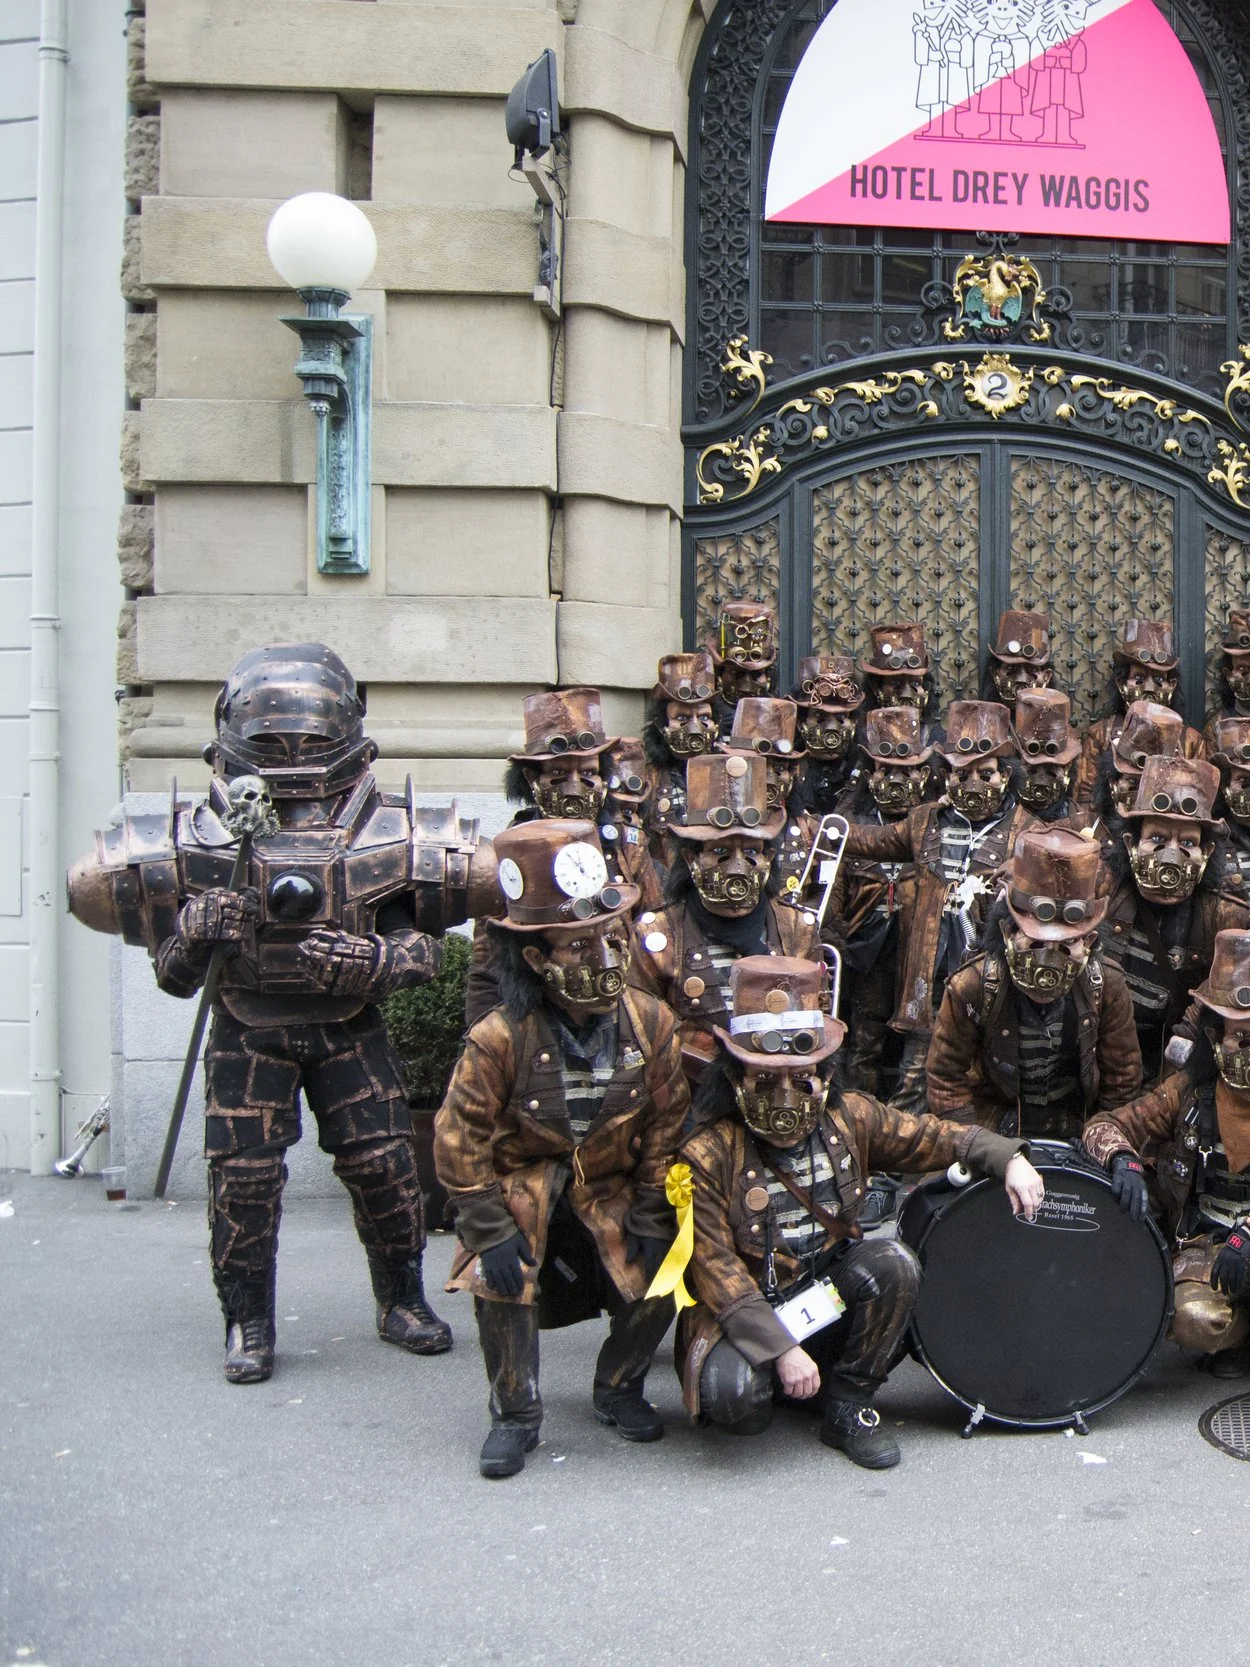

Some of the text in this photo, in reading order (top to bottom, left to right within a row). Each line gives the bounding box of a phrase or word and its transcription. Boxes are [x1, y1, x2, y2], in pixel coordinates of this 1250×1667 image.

[850, 164, 1150, 213] HOTEL DREY WAGGIS
[988, 372, 1008, 399] 2
[1044, 1211, 1074, 1221] Basel 1965
[800, 1307, 816, 1325] 1
